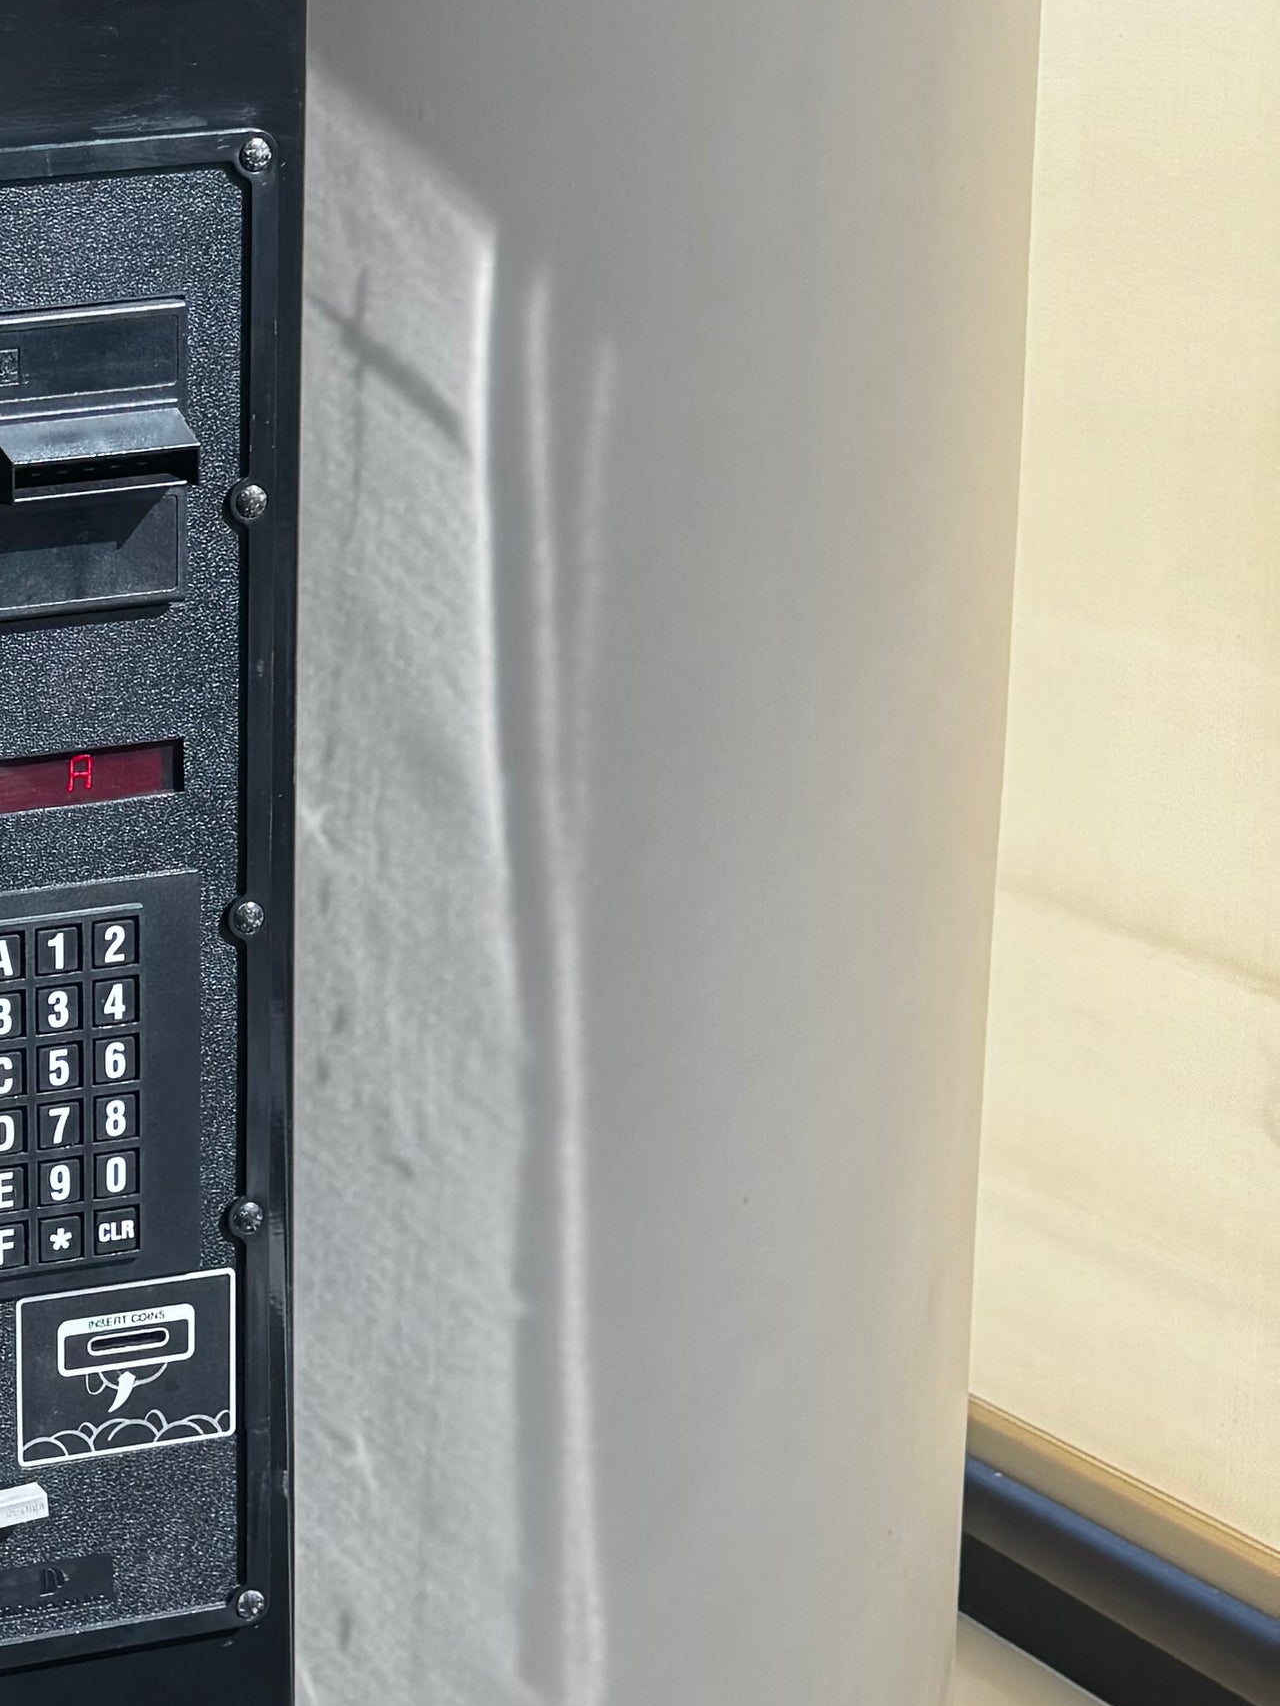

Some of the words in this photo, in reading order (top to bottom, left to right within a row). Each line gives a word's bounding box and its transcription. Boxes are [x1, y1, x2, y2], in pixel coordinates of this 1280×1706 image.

[66, 754, 92, 792] A
[47, 932, 65, 969] 1
[103, 925, 125, 963] 2
[47, 990, 69, 1029] 3
[103, 983, 126, 1020] 4
[48, 1048, 70, 1086] 5
[104, 1041, 126, 1079] 6
[49, 1106, 70, 1144] 7
[104, 1099, 126, 1137] 8
[49, 1164, 71, 1201] 9
[106, 1156, 127, 1193] 0
[98, 1219, 135, 1243] CLR
